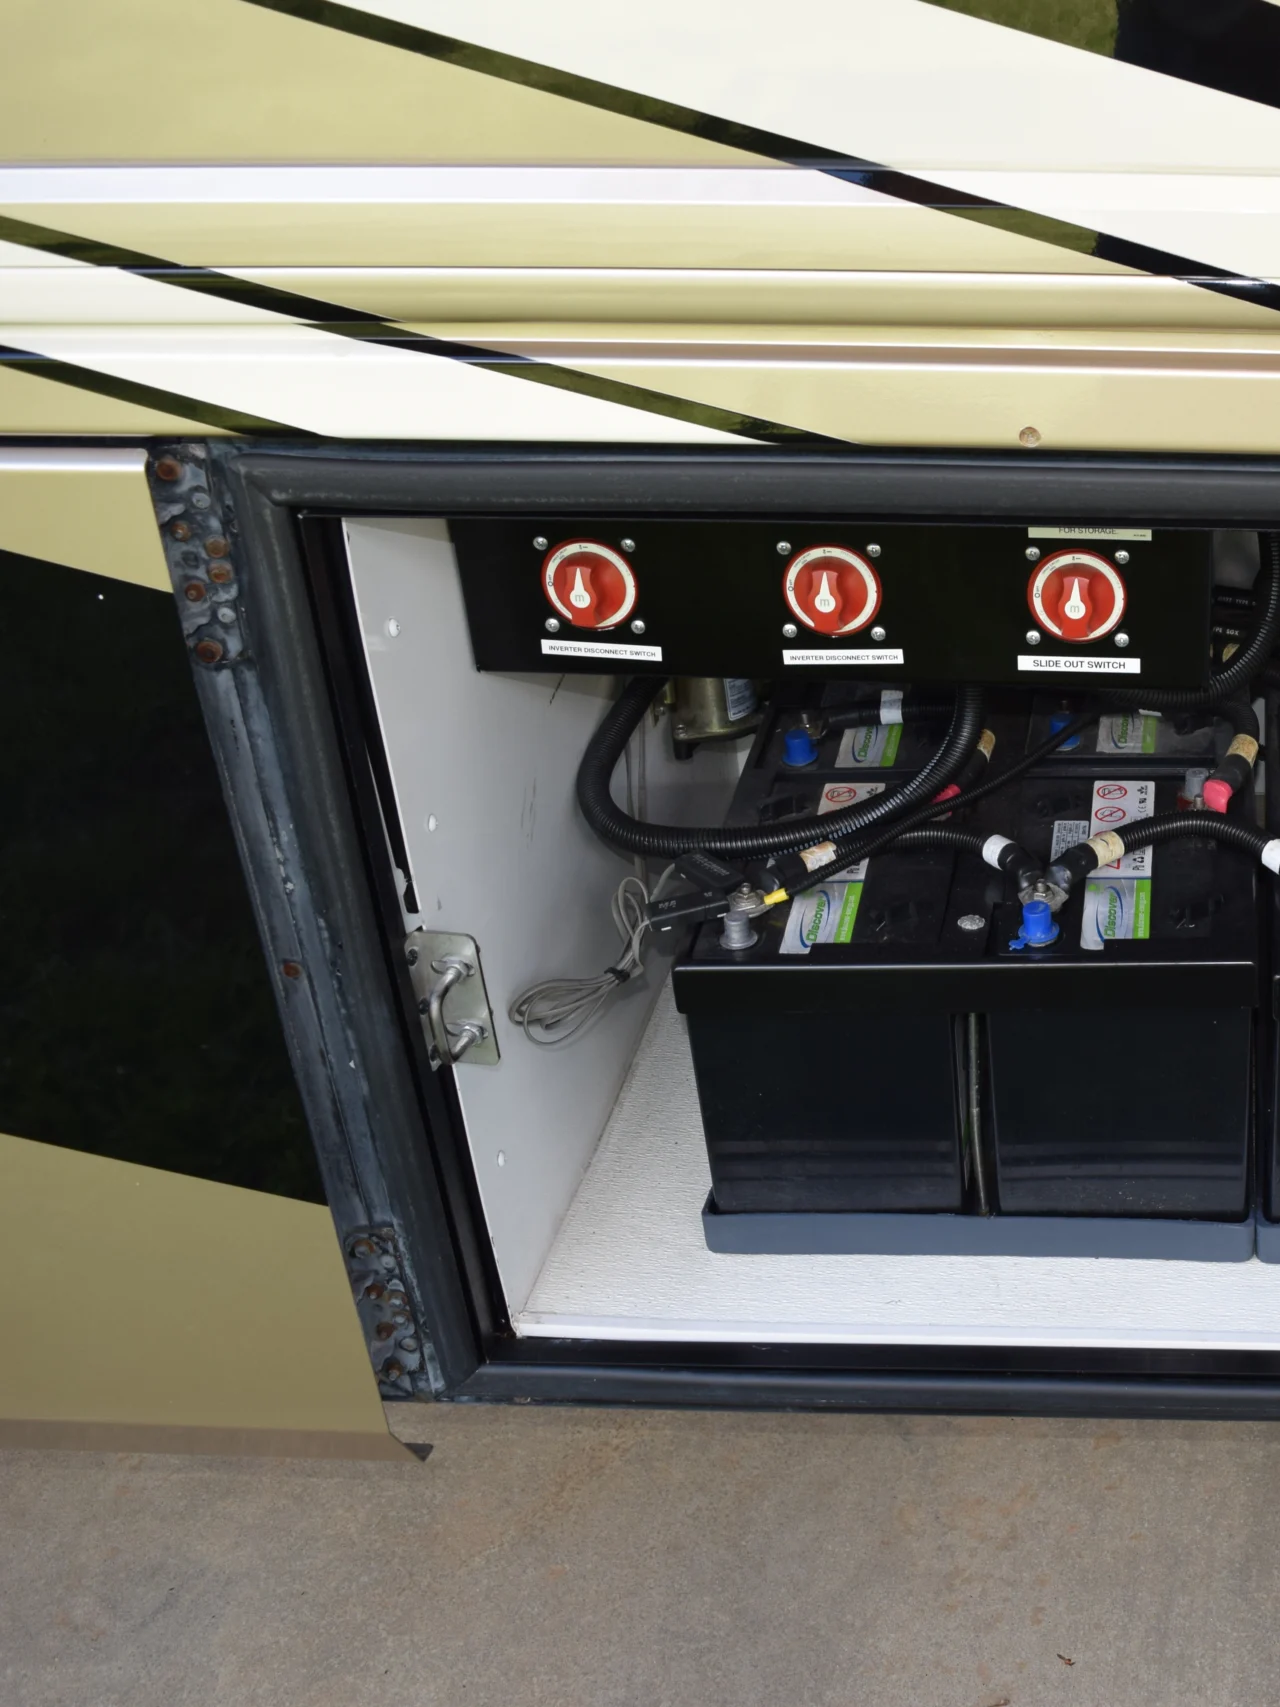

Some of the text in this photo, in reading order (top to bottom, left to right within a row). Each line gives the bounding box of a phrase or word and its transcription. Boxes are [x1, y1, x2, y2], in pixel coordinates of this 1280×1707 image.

[548, 645, 656, 657] INVERTER DISCONNECT SWITCH
[1032, 659, 1126, 670] SLIDE OUT SWITCH
[806, 896, 826, 944] Discover
[1104, 892, 1119, 938] Discover
